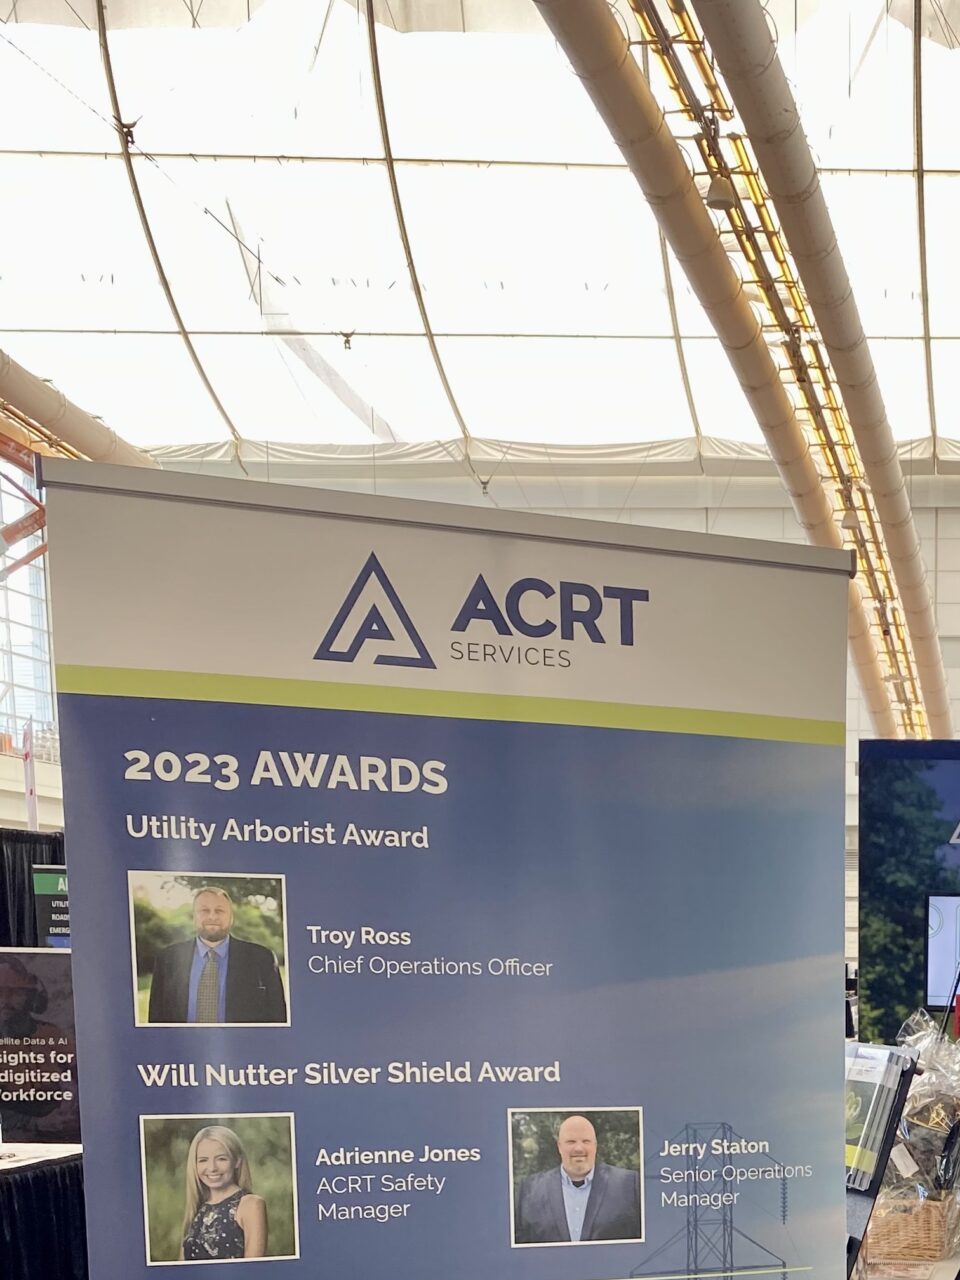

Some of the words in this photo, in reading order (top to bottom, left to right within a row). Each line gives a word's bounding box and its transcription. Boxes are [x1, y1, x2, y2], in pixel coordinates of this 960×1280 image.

[450, 573, 650, 646] ACRT
[450, 641, 571, 668] SERVICES
[123, 750, 240, 790] 2023
[251, 750, 449, 795] AWARDS
[125, 815, 216, 846] Utility
[222, 819, 336, 845] Arborist
[342, 824, 429, 849] Award
[306, 925, 355, 949] Troy
[361, 927, 411, 946] Ross
[308, 955, 363, 975] Chief
[369, 957, 482, 978] Operations
[487, 958, 553, 977] Officer
[0, 1050, 45, 1066] ights
[49, 1051, 74, 1063] for
[0, 1069, 71, 1084] digitized
[138, 1063, 198, 1086] Will
[205, 1063, 298, 1086] Nutter
[304, 1062, 381, 1085] Silver
[387, 1062, 472, 1083] Shield
[478, 1061, 561, 1083] Award
[0, 1089, 73, 1101] orkforce
[315, 1147, 415, 1166] Adrienne
[419, 1145, 481, 1163] Jones
[660, 1140, 706, 1160] Jerry
[711, 1139, 769, 1155] Staton
[316, 1175, 376, 1194] ACRT
[381, 1173, 446, 1194] Safety
[660, 1166, 717, 1184] Senior
[722, 1163, 813, 1182] Operations
[661, 1190, 740, 1210] Manager
[318, 1203, 411, 1222] Manager
